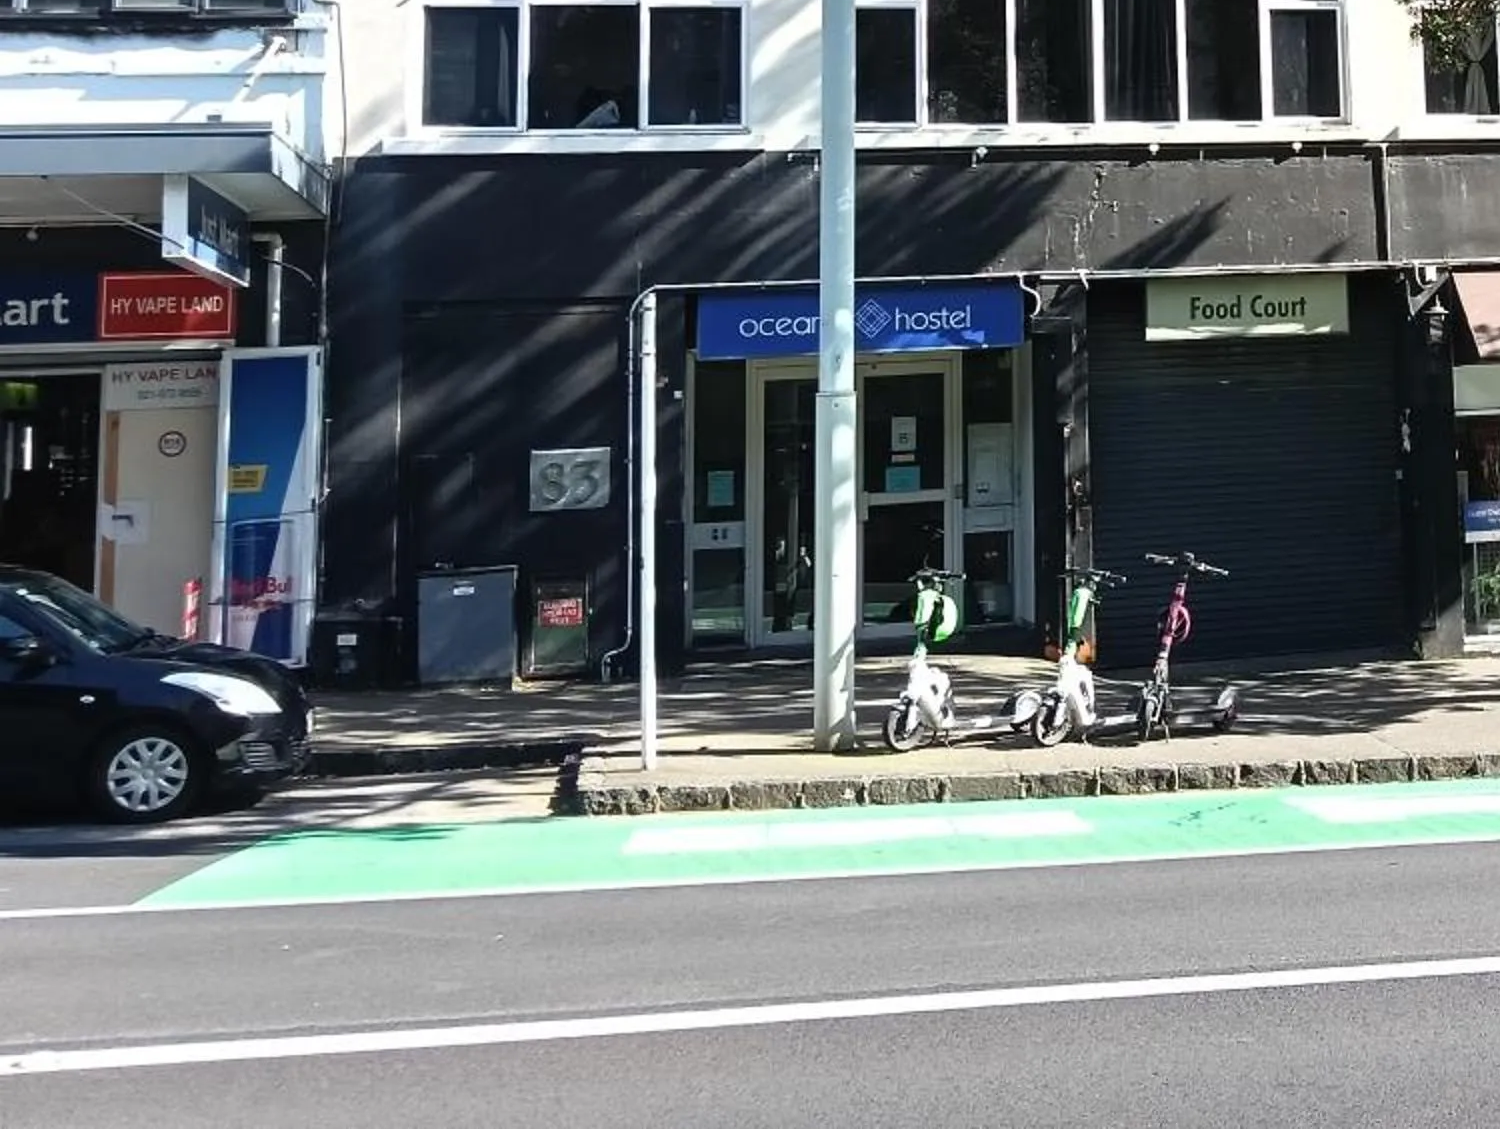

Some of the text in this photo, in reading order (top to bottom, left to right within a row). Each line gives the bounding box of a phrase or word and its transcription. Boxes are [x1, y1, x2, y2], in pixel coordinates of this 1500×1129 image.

[0, 292, 70, 326] art
[111, 295, 224, 315] HY VAPE LAND
[1190, 294, 1307, 319] Food Court
[739, 305, 971, 338] ocean hostel
[112, 367, 217, 383] HY VAPE LAN
